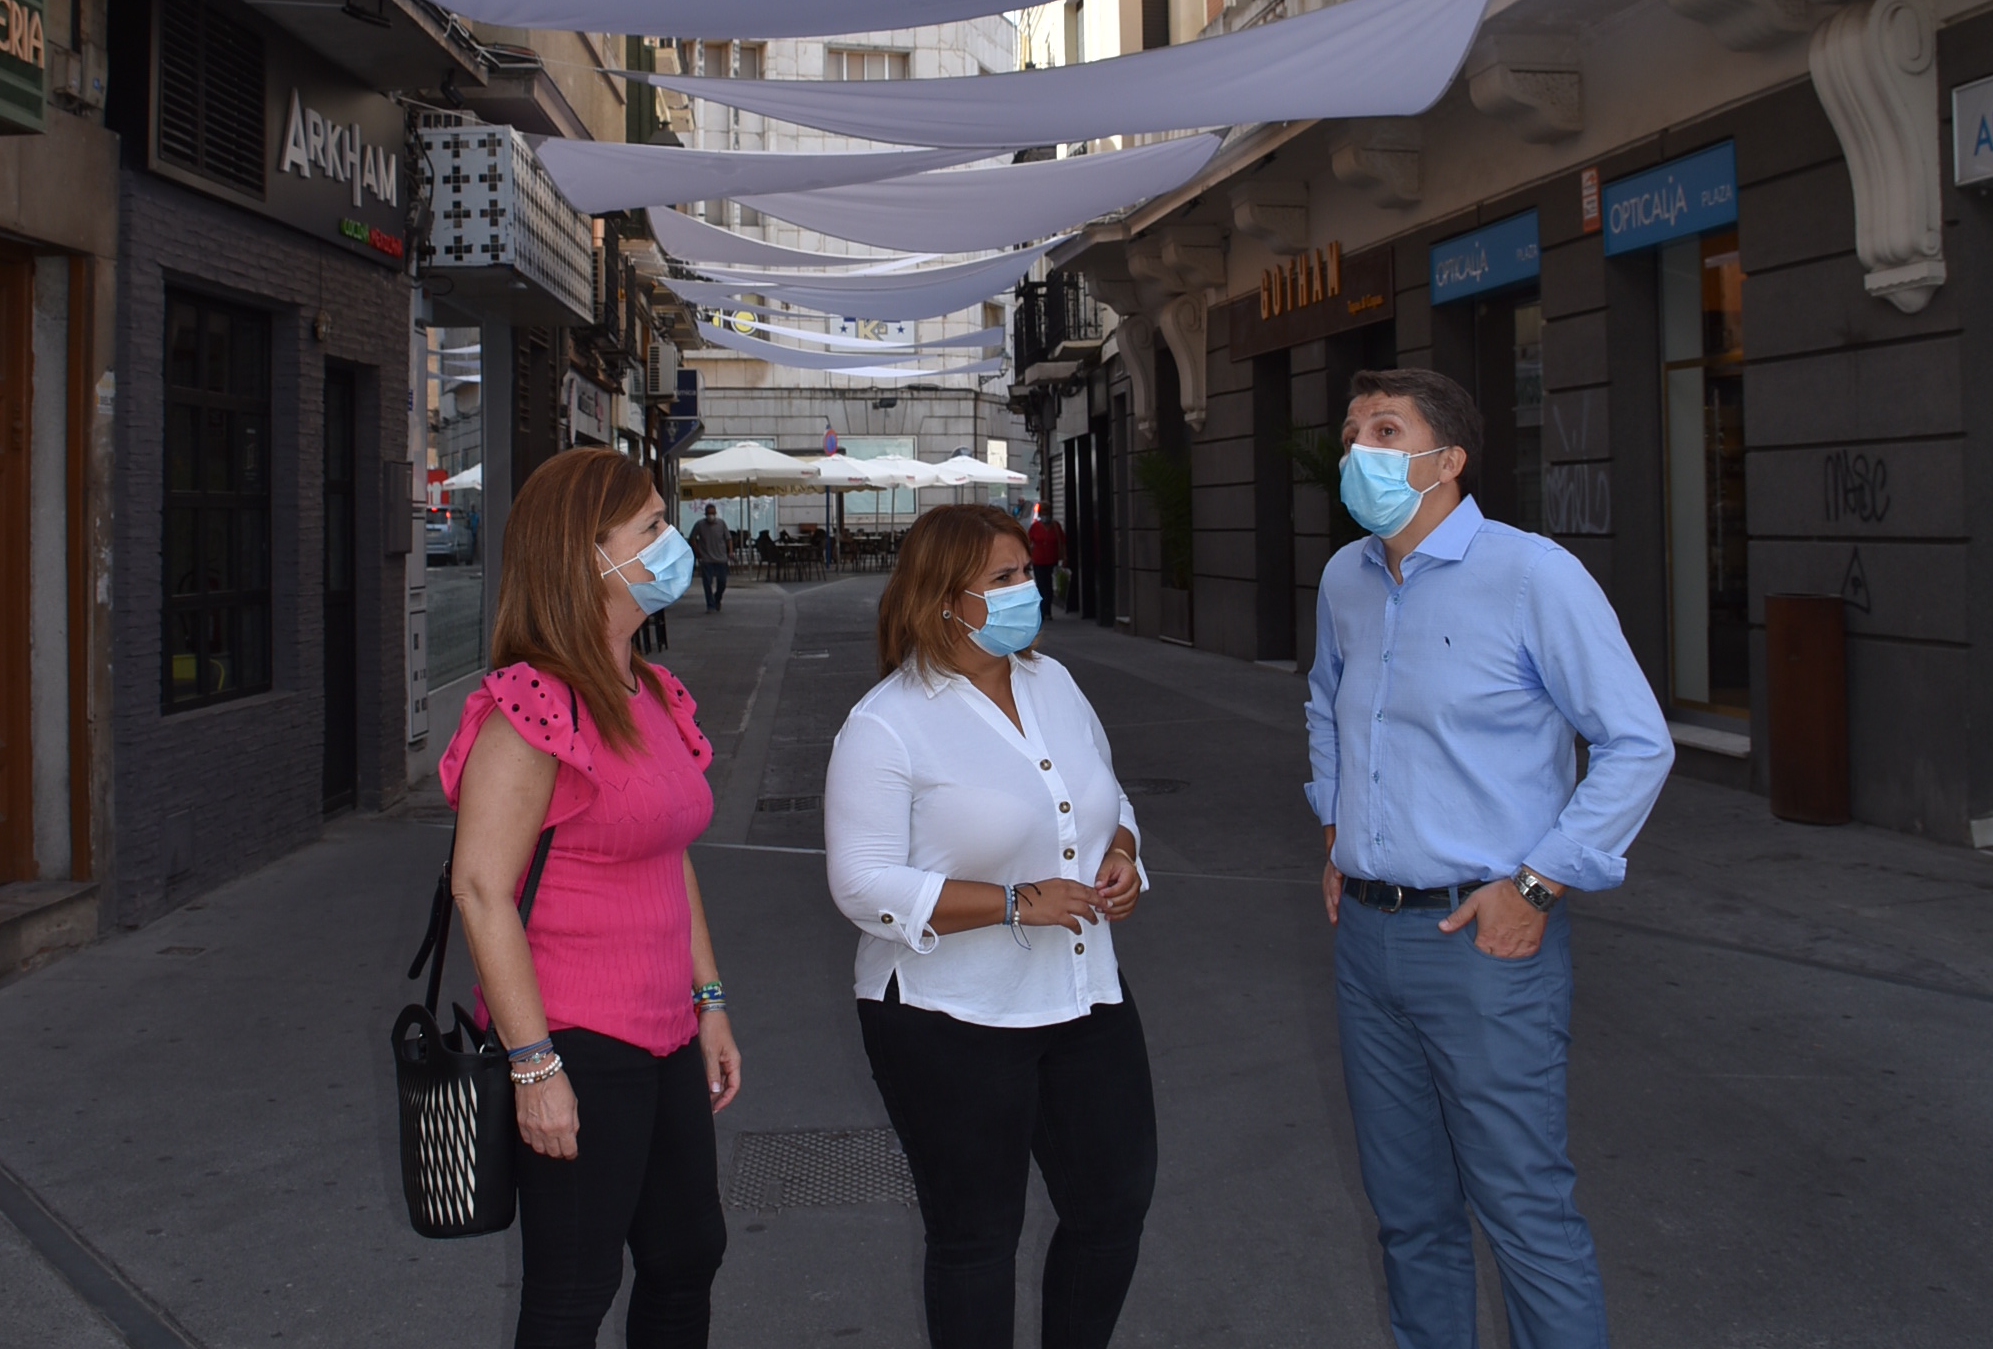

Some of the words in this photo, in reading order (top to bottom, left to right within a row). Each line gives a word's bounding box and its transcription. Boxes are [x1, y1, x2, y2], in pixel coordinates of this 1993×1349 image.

[279, 87, 397, 208] ARKHAM
[1701, 184, 1733, 208] PLAZA
[1260, 240, 1341, 321] GOTHAM
